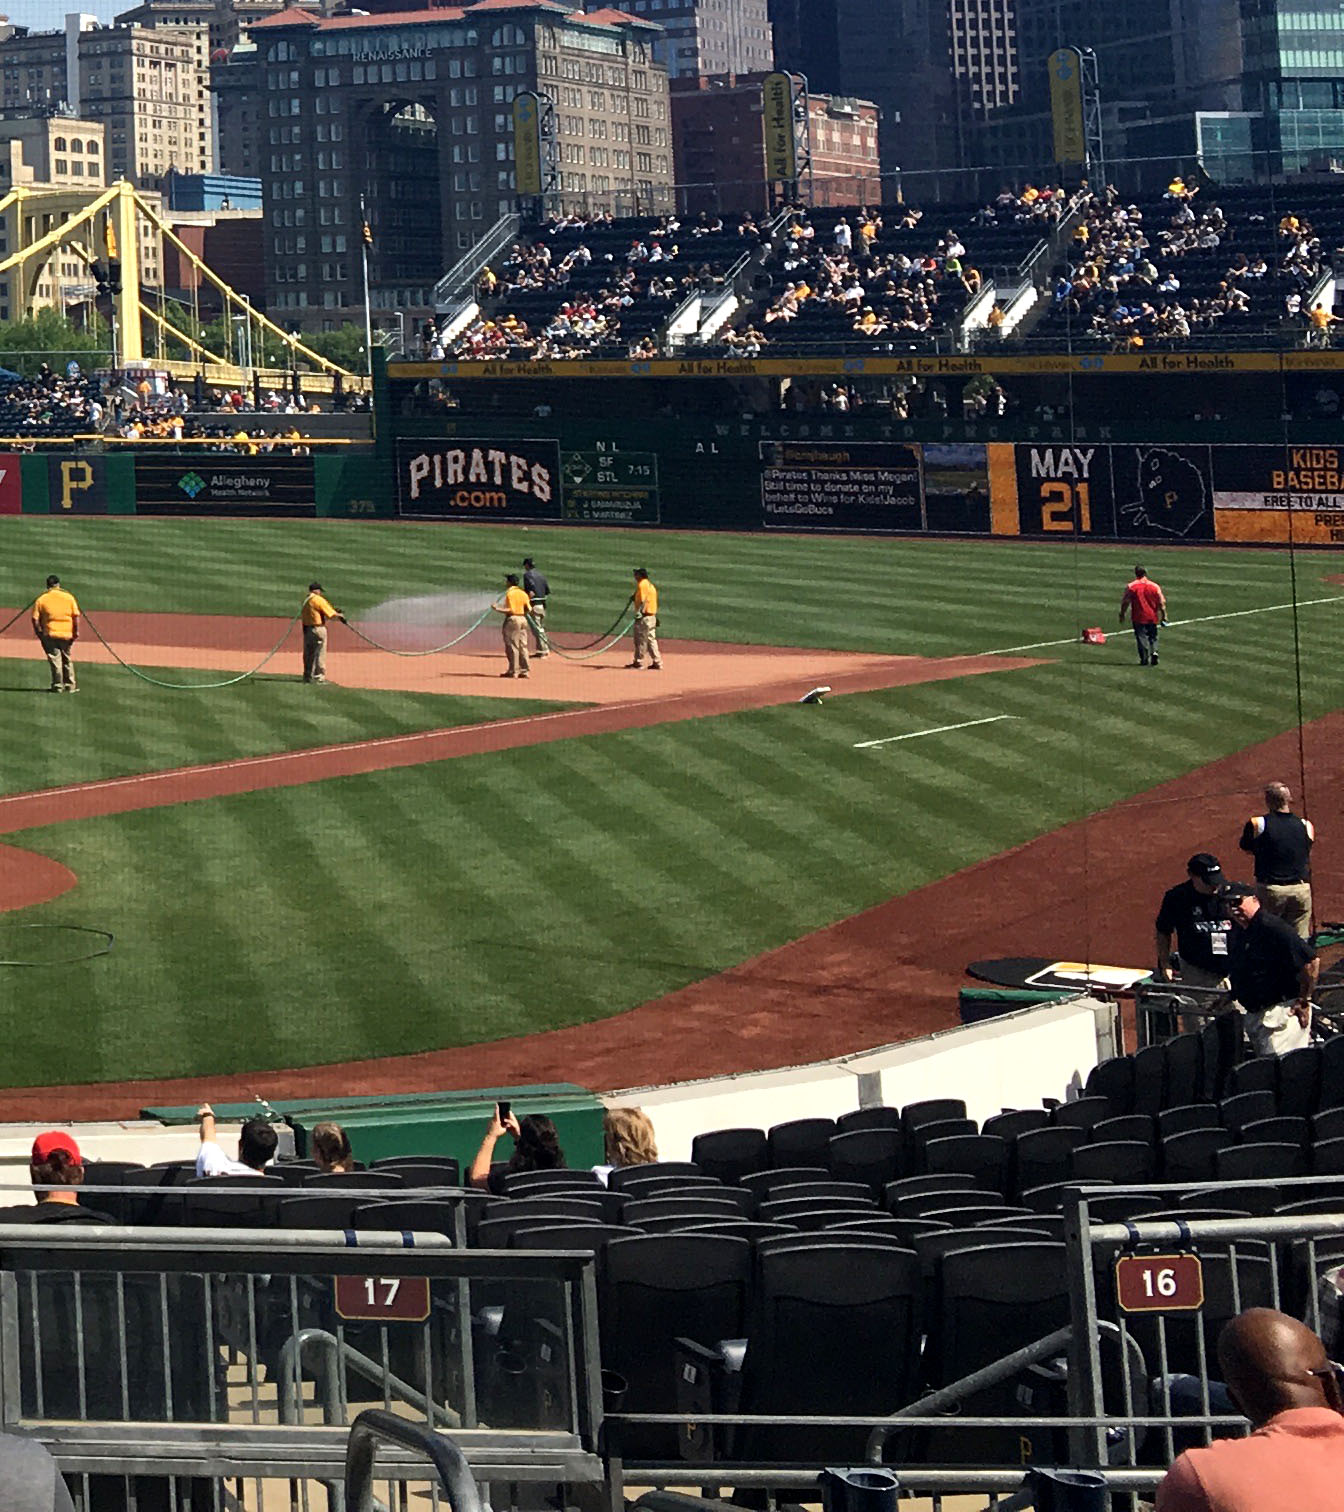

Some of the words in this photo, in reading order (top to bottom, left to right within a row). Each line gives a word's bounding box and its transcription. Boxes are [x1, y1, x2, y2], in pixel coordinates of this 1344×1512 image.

[353, 47, 433, 62] RENAISSANCE
[678, 362, 694, 374] All
[696, 362, 713, 374] for
[716, 361, 756, 373] Health
[896, 360, 912, 372] All
[917, 360, 936, 372] for
[938, 359, 982, 372] Health
[1139, 358, 1160, 369] All
[1162, 358, 1183, 369] for
[1186, 357, 1235, 370] Health
[1031, 447, 1096, 479] MAY
[1292, 449, 1339, 469] KIDS
[210, 474, 271, 488] Allegheny
[409, 447, 552, 503] PIRATES
[597, 471, 619, 483] STL
[811, 471, 847, 481] Thanks
[850, 471, 875, 482] Miss
[60, 460, 95, 509] P
[824, 482, 860, 492] donate
[878, 484, 894, 495] my
[449, 489, 507, 508] .com
[1263, 495, 1295, 508] FREE
[1295, 495, 1313, 508] TO
[1317, 496, 1342, 509] ALL
[1040, 480, 1093, 533] 21
[1141, 1268, 1178, 1298] 16
[363, 1278, 399, 1308] 17
